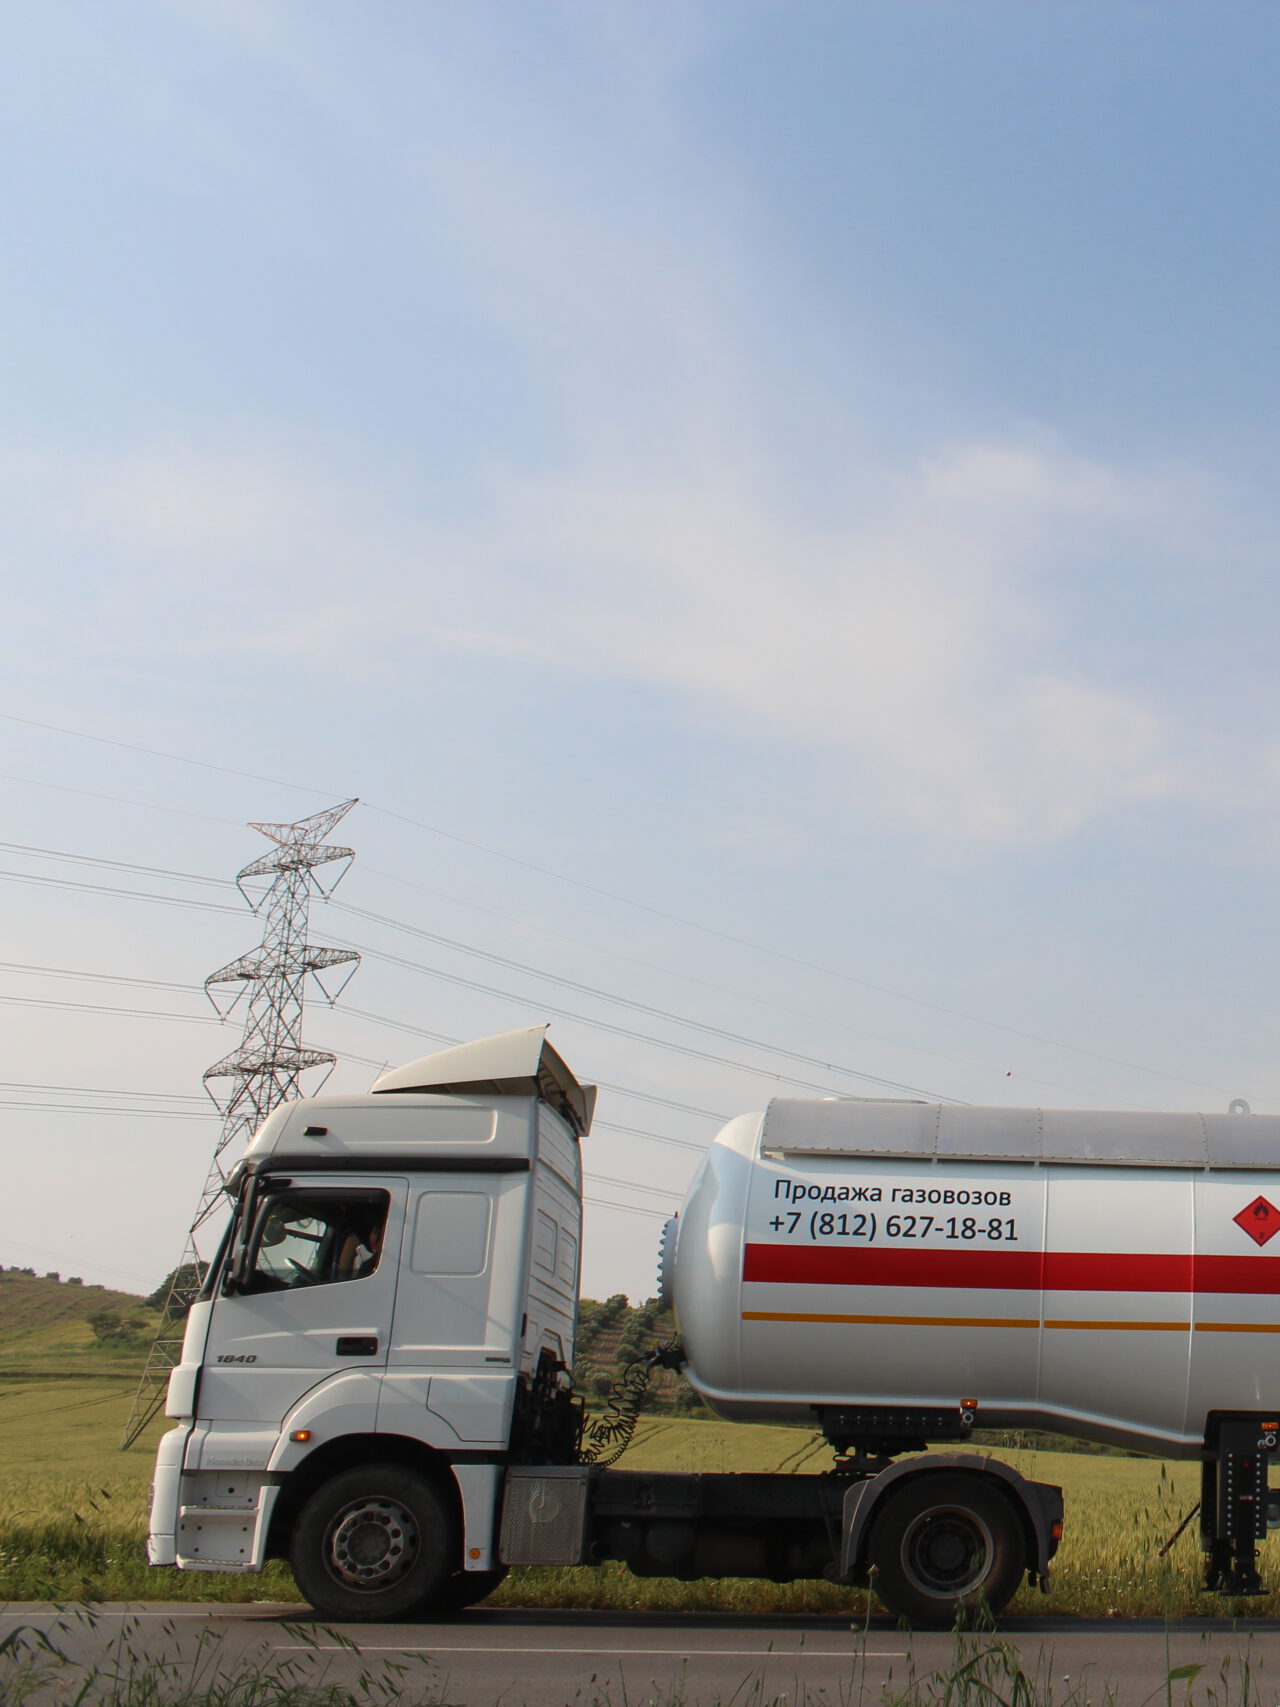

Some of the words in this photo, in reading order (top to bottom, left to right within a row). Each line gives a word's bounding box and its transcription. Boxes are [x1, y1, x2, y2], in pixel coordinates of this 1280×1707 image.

[774, 1179, 882, 1204] Продажа
[891, 1187, 1011, 1206] газовозов
[769, 1212, 801, 1234] +7
[810, 1211, 877, 1242] (812)
[886, 1215, 1018, 1241] 627-18-81
[216, 1354, 257, 1363] 1840
